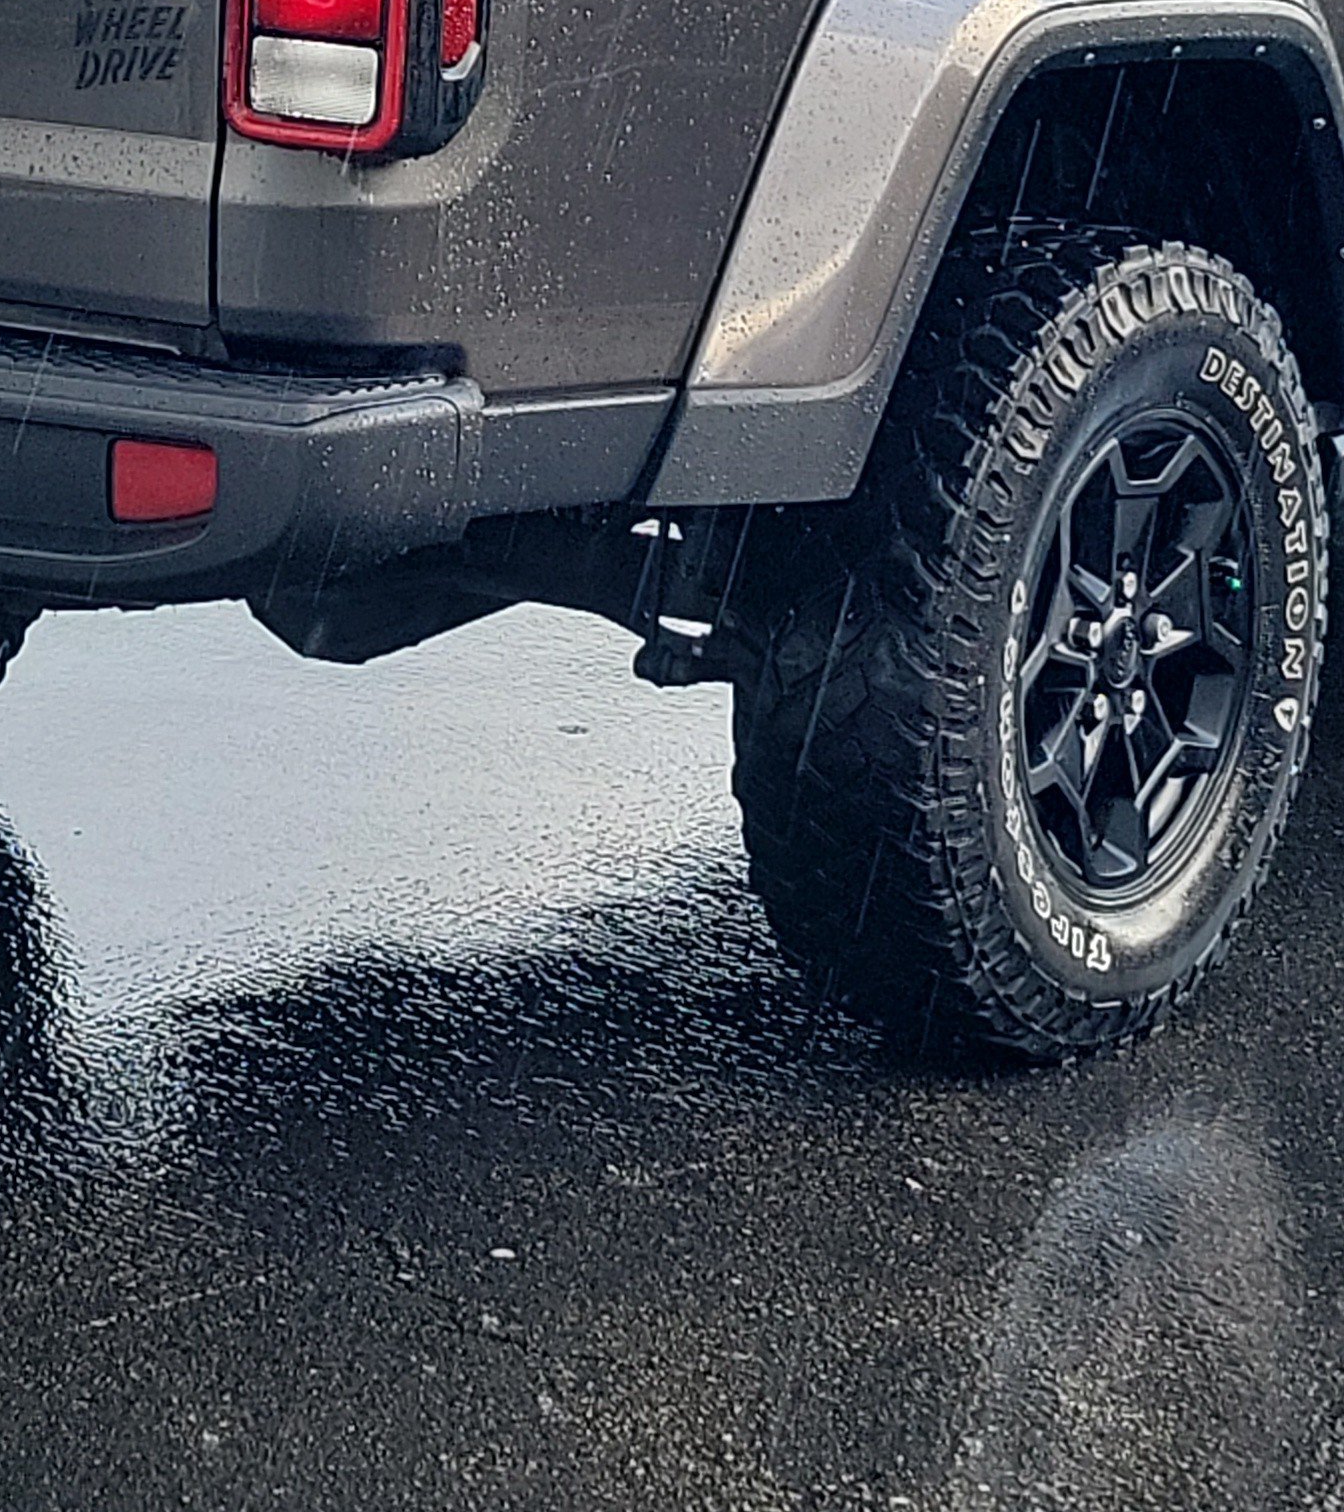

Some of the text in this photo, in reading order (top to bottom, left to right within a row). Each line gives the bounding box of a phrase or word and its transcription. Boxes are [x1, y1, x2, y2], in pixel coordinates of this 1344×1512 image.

[74, 6, 188, 48] WHEEL
[74, 45, 185, 90] DRIVE
[1199, 346, 1311, 681] DESTINATION
